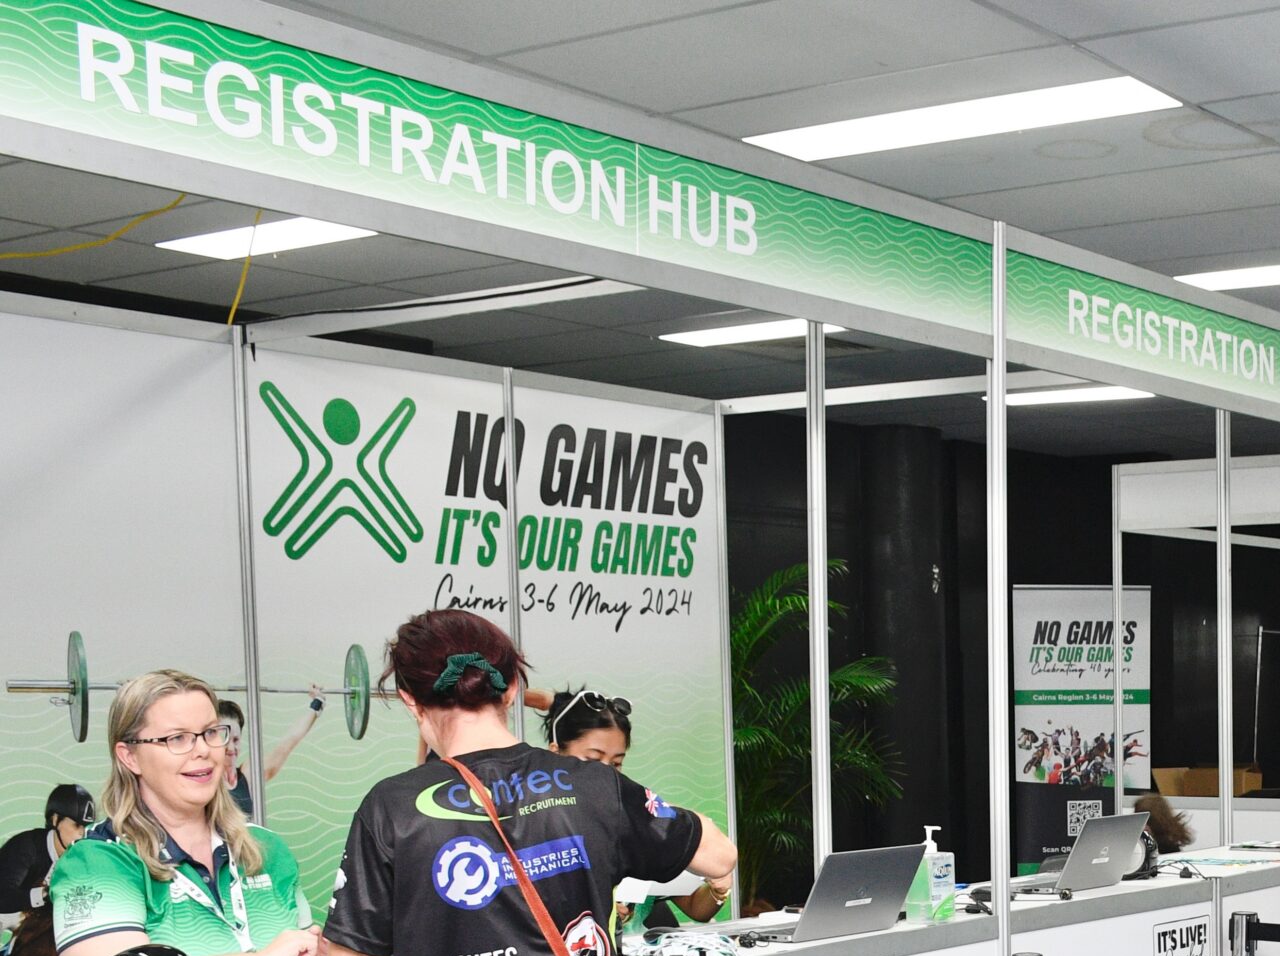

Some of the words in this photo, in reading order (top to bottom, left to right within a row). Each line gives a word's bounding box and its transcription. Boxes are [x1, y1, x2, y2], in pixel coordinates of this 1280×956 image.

[77, 22, 625, 228] REGISTRATION
[649, 174, 758, 256] HUB
[1068, 289, 1275, 385] REGISTRATION
[445, 410, 525, 510] NQ
[540, 423, 708, 518] GAMES
[435, 508, 500, 567] IT'S
[517, 515, 583, 572] OUR
[590, 520, 697, 578] GAMES
[434, 573, 508, 613] Cairns
[521, 582, 558, 612] 3-6
[569, 581, 632, 632] May
[639, 587, 693, 616] 2024
[1033, 620, 1061, 646] NQ
[1067, 620, 1137, 645] GAMS
[1029, 646, 1054, 663] IT'S
[1057, 646, 1083, 663] OUR
[1086, 646, 1133, 663] GAMS
[1031, 660, 1086, 679] Celebrating
[1105, 667, 1131, 679] yers
[1058, 693, 1083, 702] Region
[448, 769, 573, 808] contec
[518, 796, 577, 817] RECRUITMENT
[503, 847, 579, 872] INUSTRIES
[1157, 929, 1178, 954] IT'S
[1180, 923, 1207, 949] LIVE!
